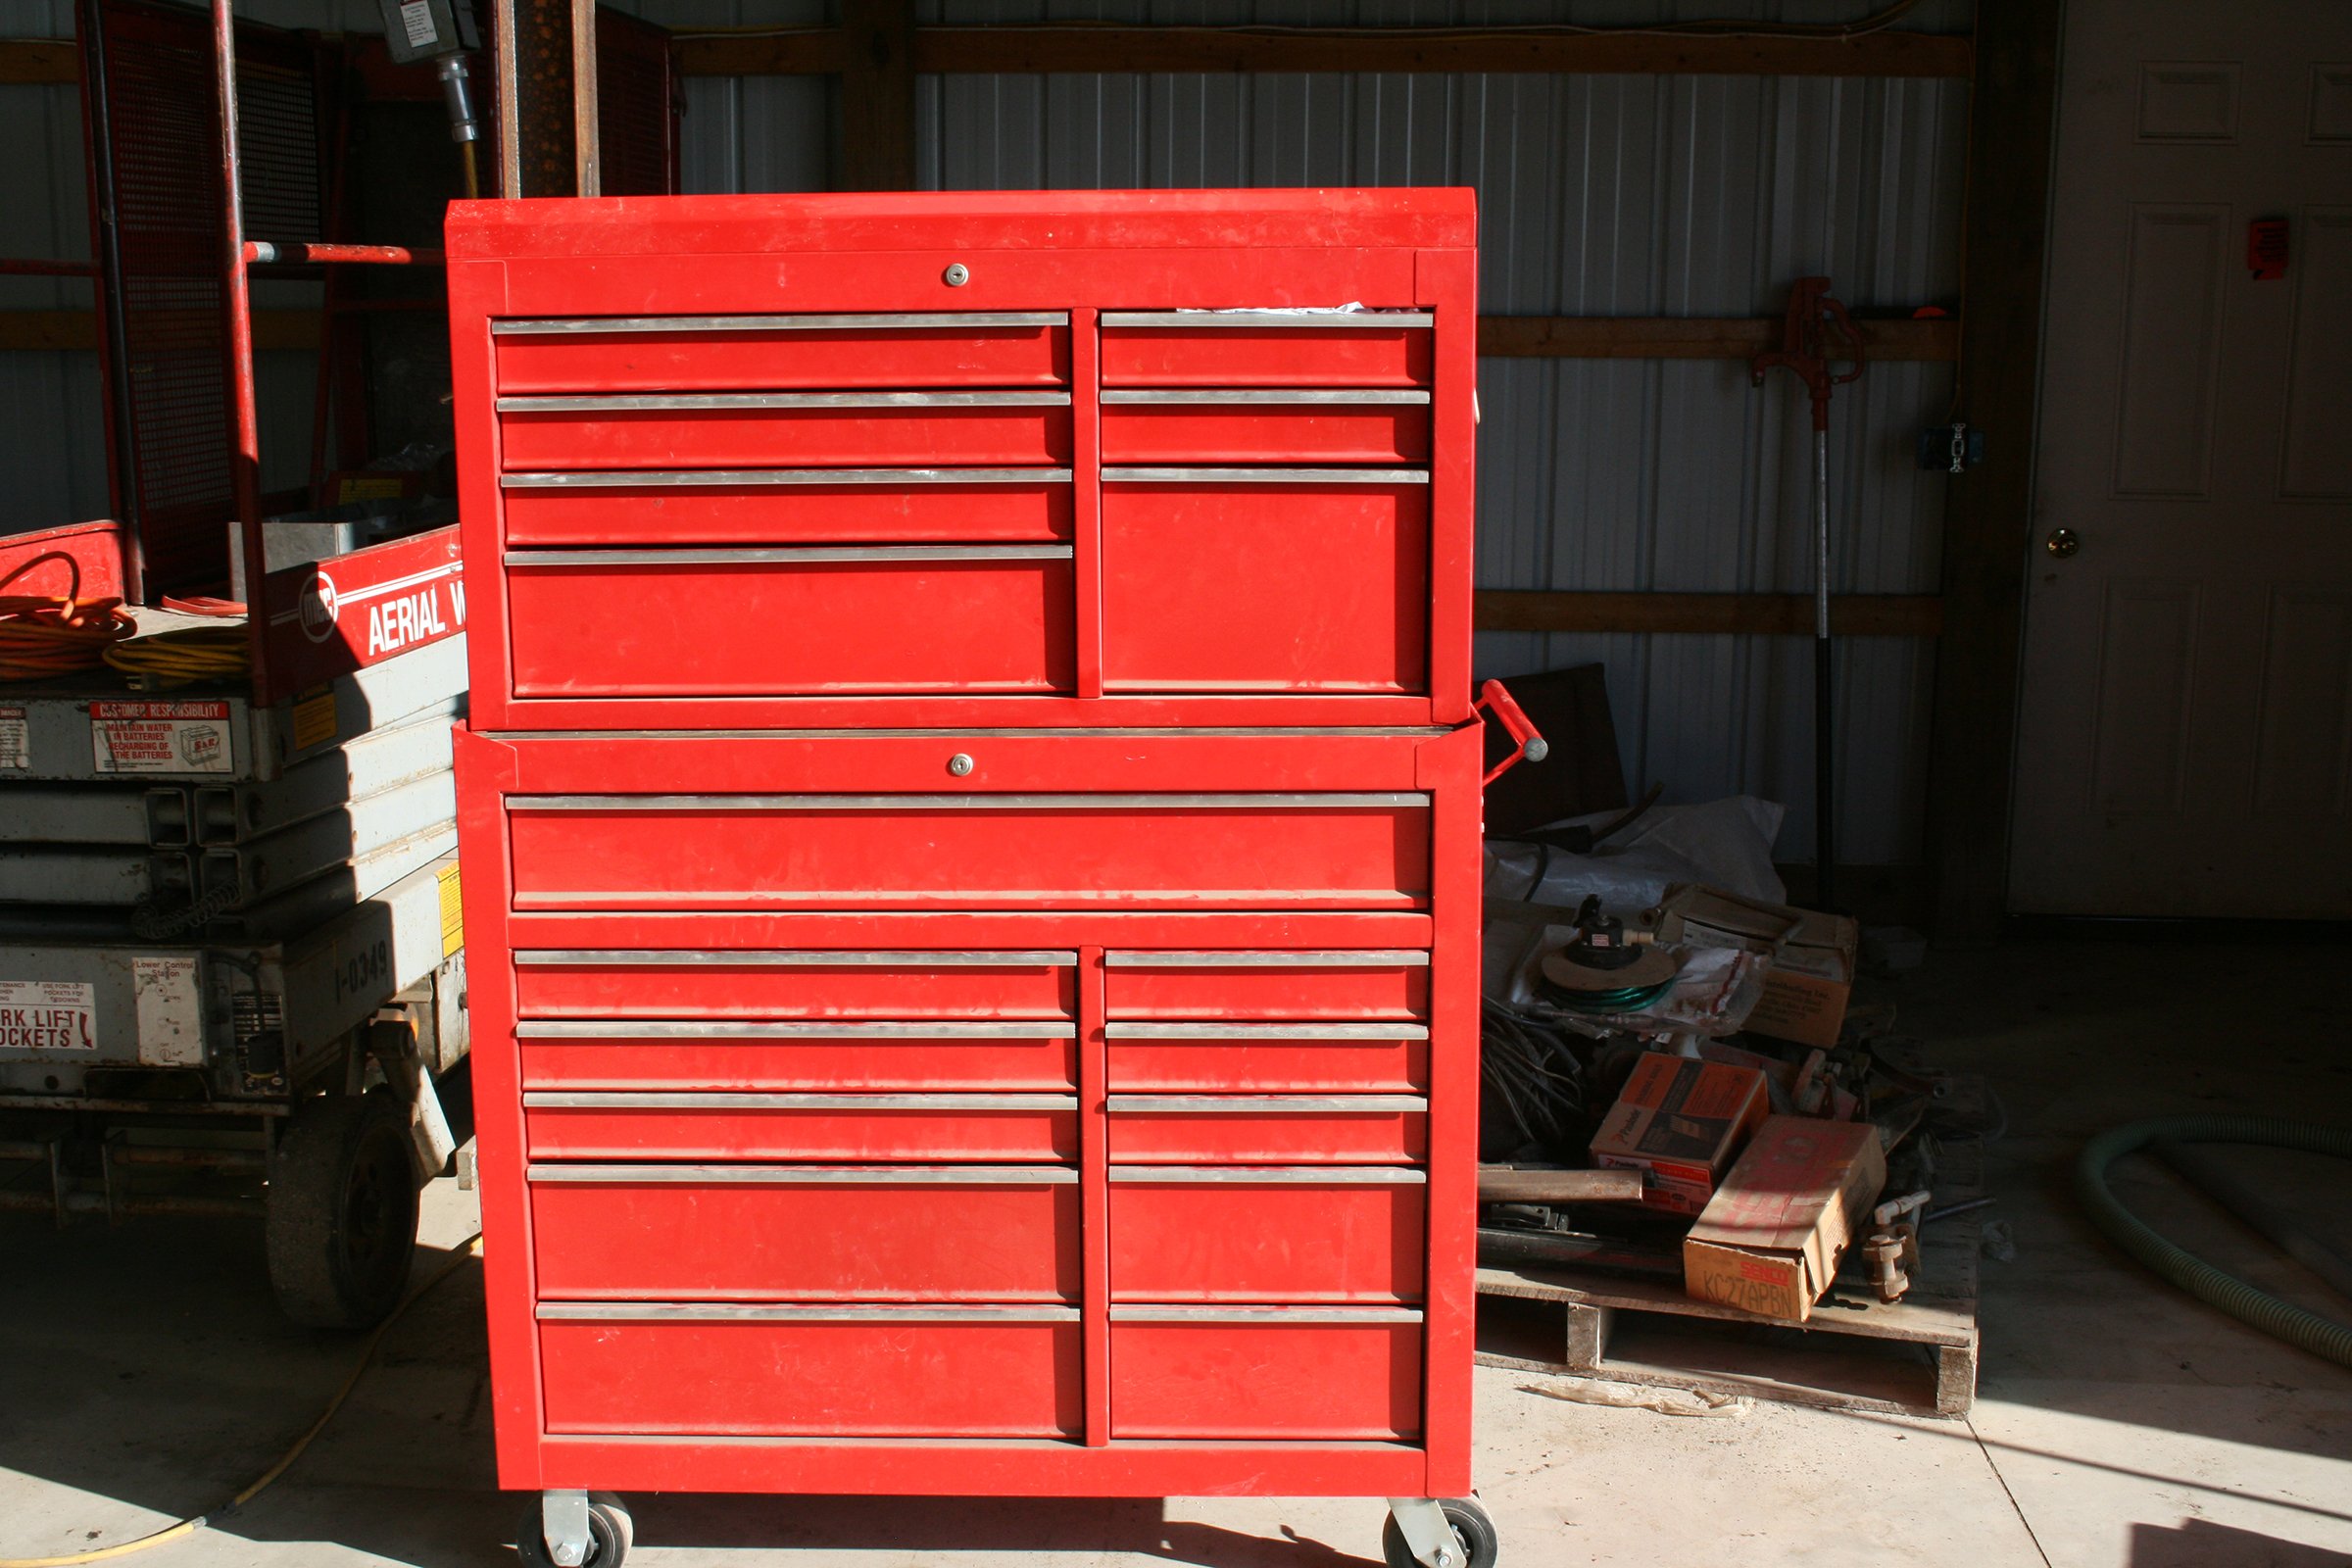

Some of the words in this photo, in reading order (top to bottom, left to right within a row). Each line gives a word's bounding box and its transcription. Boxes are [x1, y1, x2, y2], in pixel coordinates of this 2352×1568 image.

[368, 584, 446, 657] AERIAL
[146, 723, 173, 732] WATER
[123, 732, 166, 741] BATTERIES
[108, 742, 157, 751] RECHARGING
[159, 742, 169, 751] OF
[115, 751, 131, 760] THE
[132, 751, 173, 760] BATTERIES
[164, 960, 193, 969] Control
[1, 1008, 26, 1027] RK
[34, 1009, 75, 1028] LIFT
[1740, 1260, 1789, 1287] SENCO
